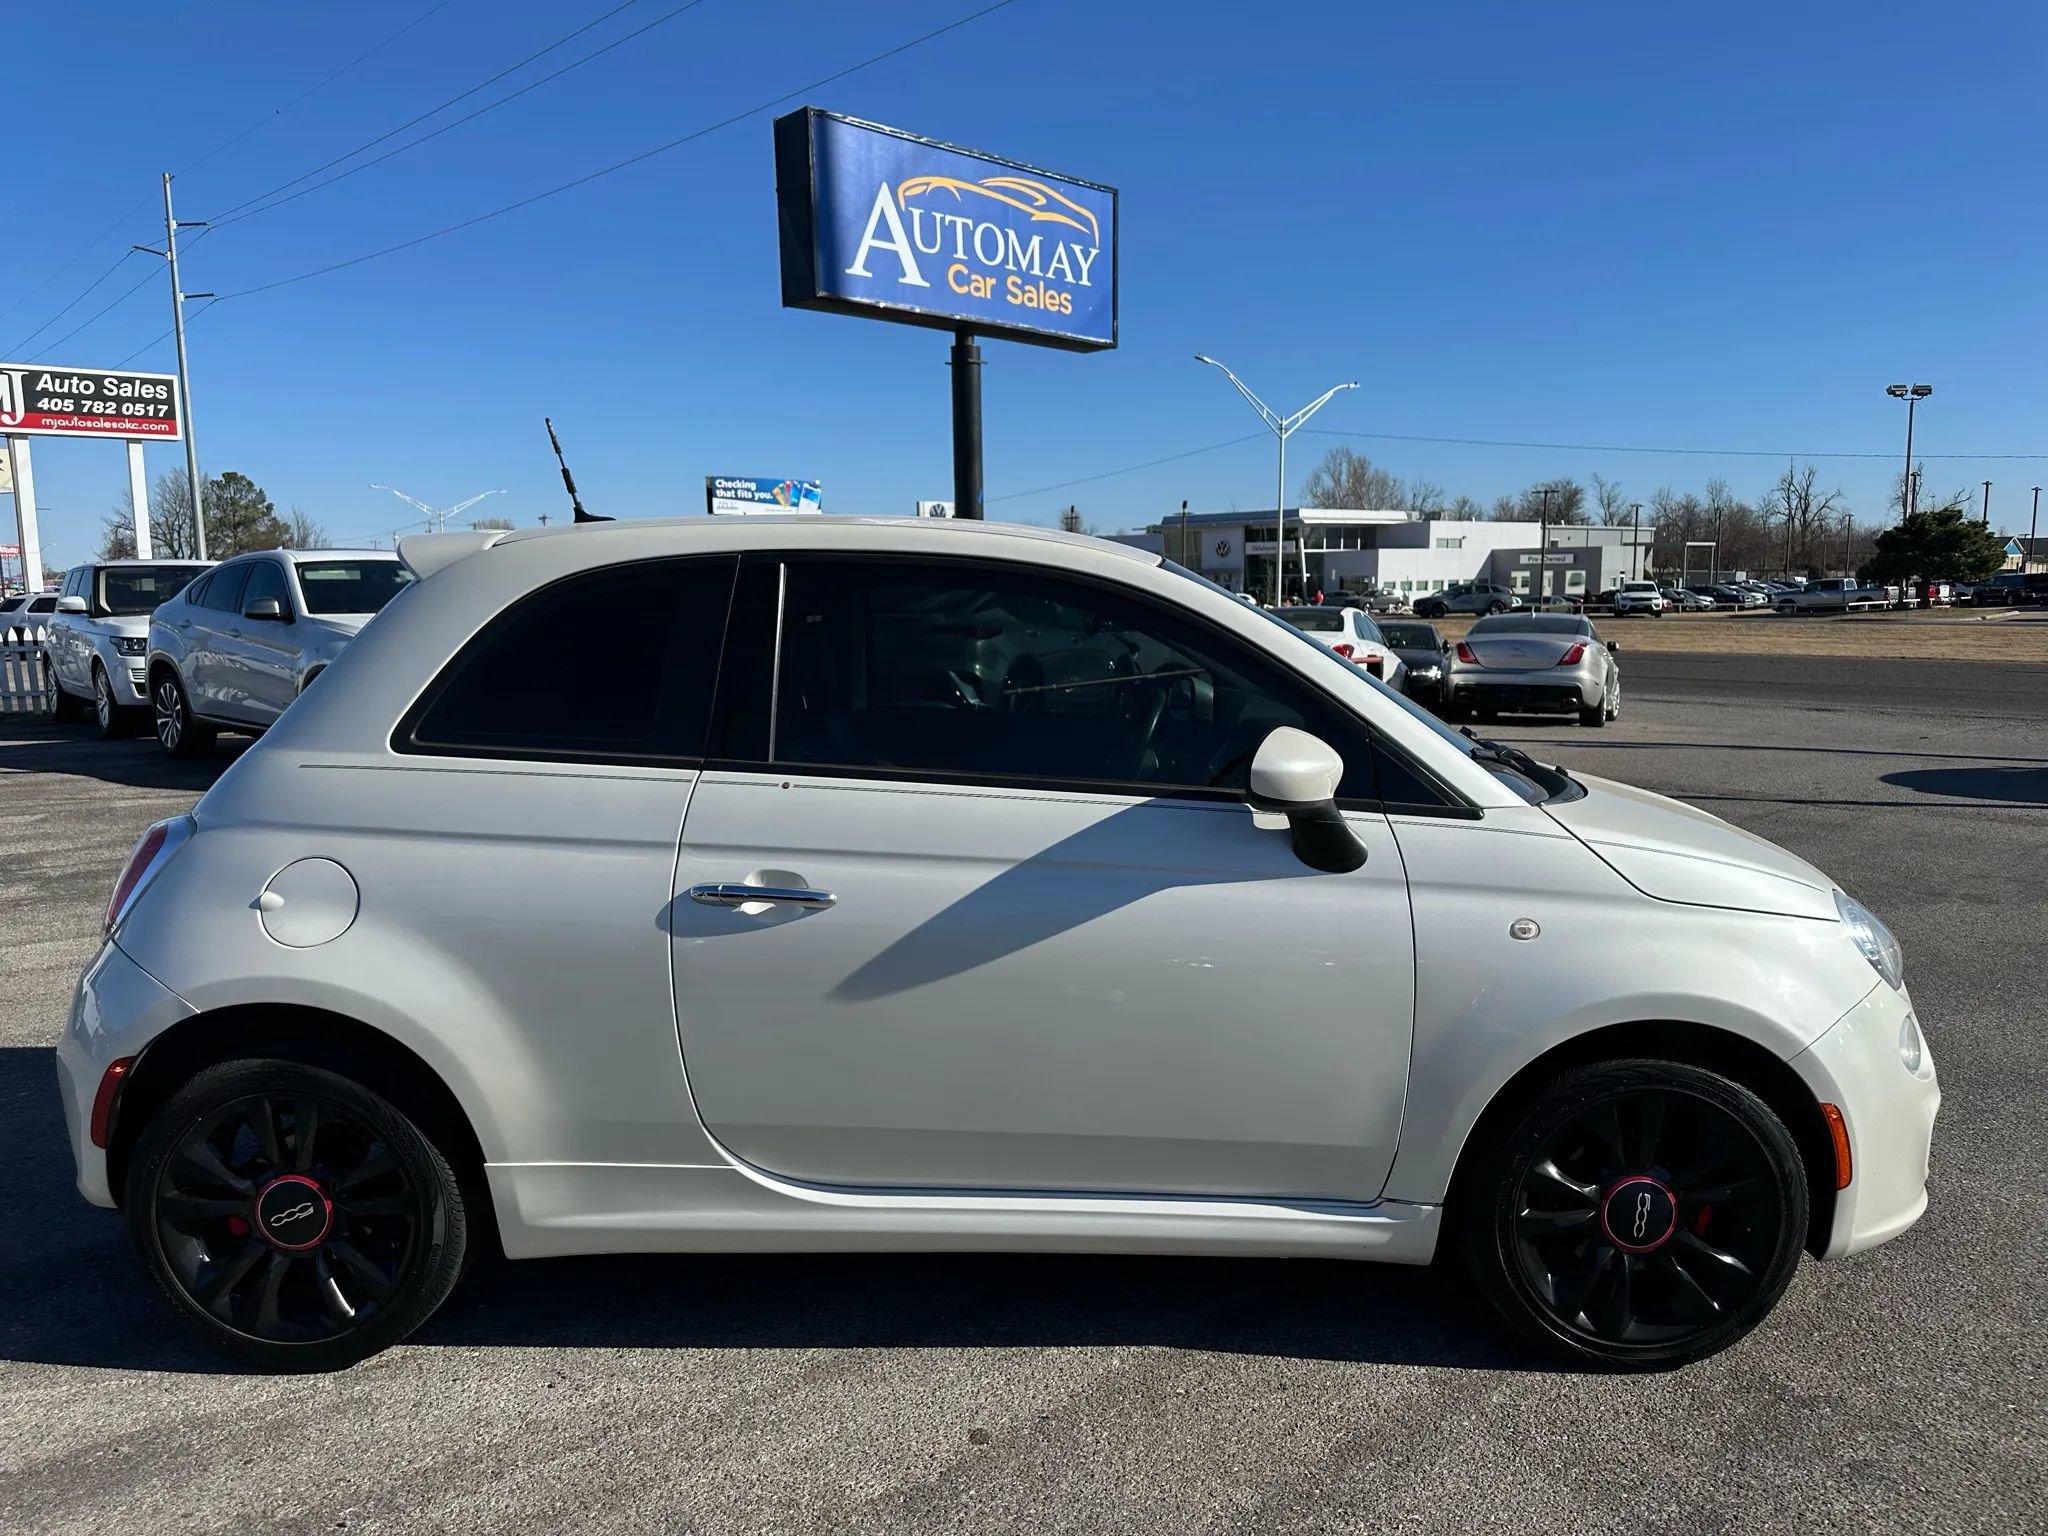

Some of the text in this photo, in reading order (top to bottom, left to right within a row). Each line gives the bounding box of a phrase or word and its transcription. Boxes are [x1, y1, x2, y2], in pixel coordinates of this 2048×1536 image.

[845, 182, 1100, 287] AUTOMAY
[947, 263, 1073, 316] Car Sales
[36, 373, 169, 400] Auto Sales
[37, 397, 169, 418] 405 782 0517
[41, 416, 170, 432] mjautosalesokc.com
[715, 479, 757, 491] Checking
[716, 489, 774, 501] that fits you.
